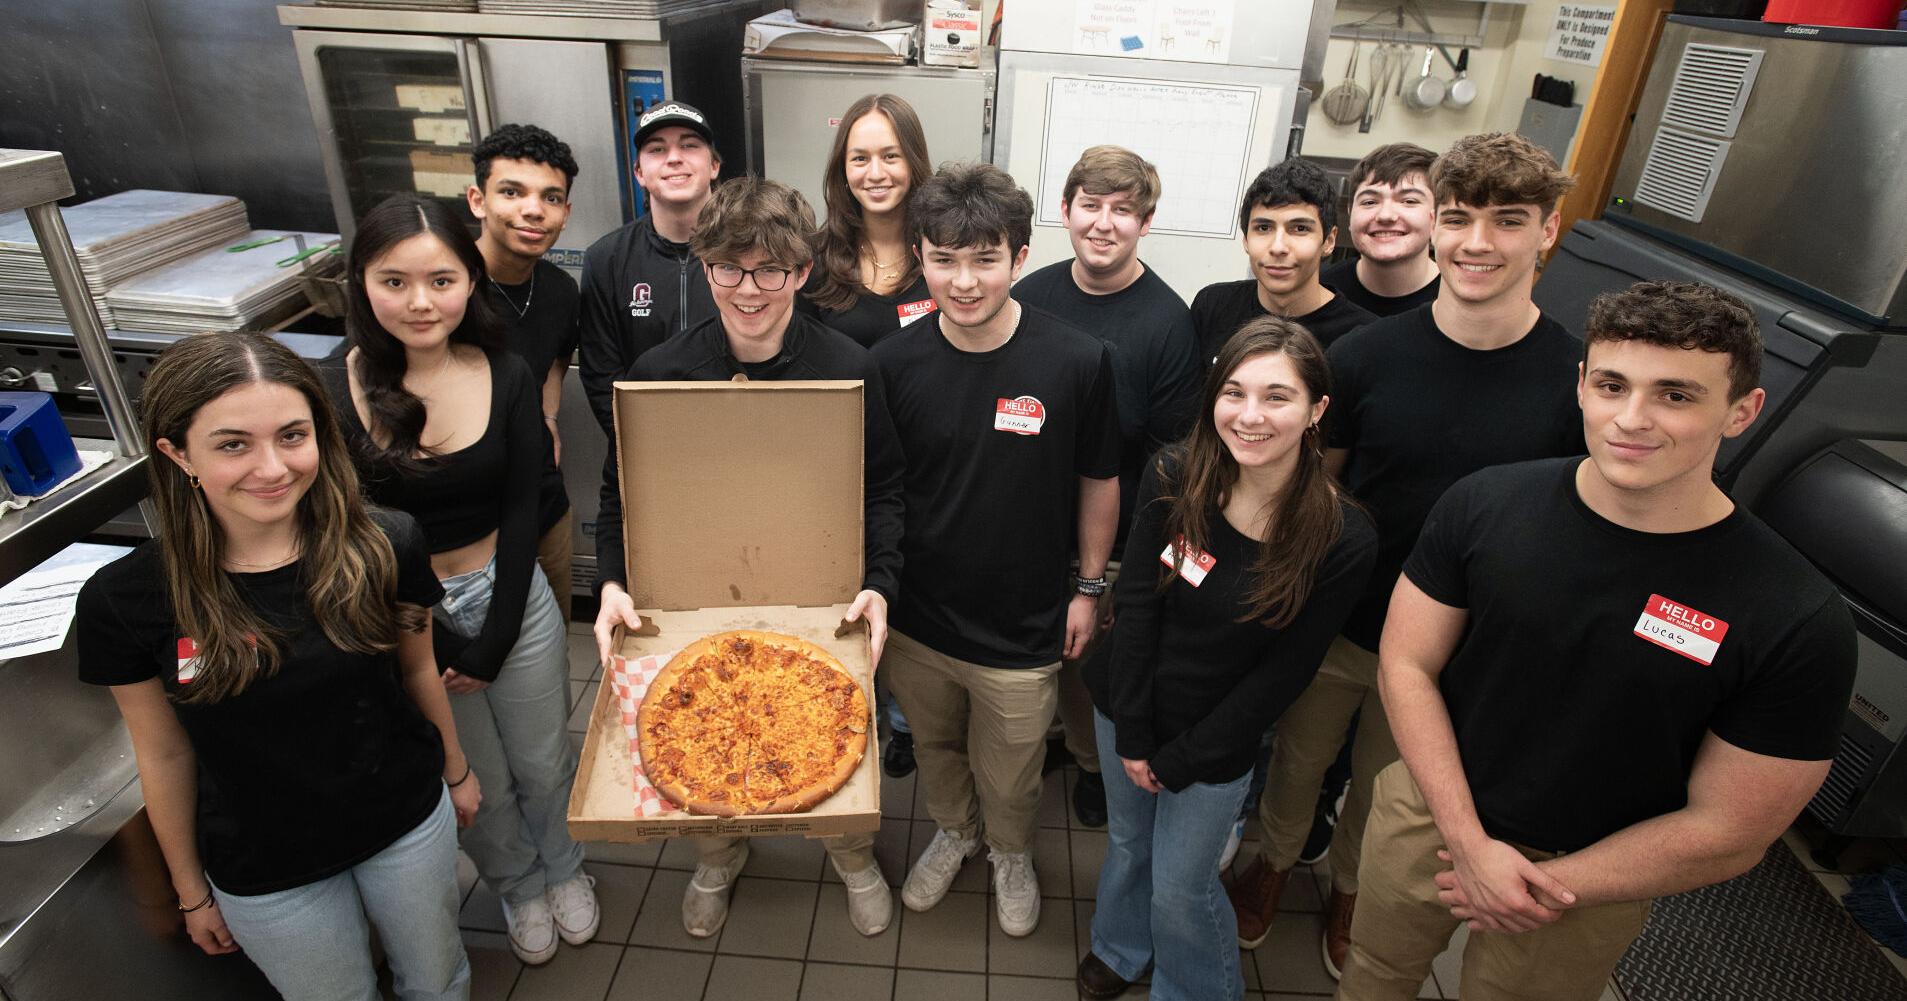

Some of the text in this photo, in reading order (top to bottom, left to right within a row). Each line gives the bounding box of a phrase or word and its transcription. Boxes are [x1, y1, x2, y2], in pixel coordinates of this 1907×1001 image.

[946, 10, 966, 19] Sysco
[1559, 6, 1615, 21] This Compartment
[1579, 22, 1609, 36] Designed
[1784, 25, 1819, 35] Scotsman
[1560, 34, 1596, 49] For Produce
[1556, 46, 1591, 61] Preparation
[542, 250, 585, 265] MPERI
[631, 308, 651, 317] GOLF
[903, 301, 932, 313] HELLO
[1005, 401, 1036, 413] HELLO
[1659, 601, 1715, 631] HELLO
[1666, 615, 1676, 623] MY
[1676, 619, 1694, 630] NAME
[1643, 619, 1685, 645] Lucas
[1855, 693, 1889, 722] UNITED
